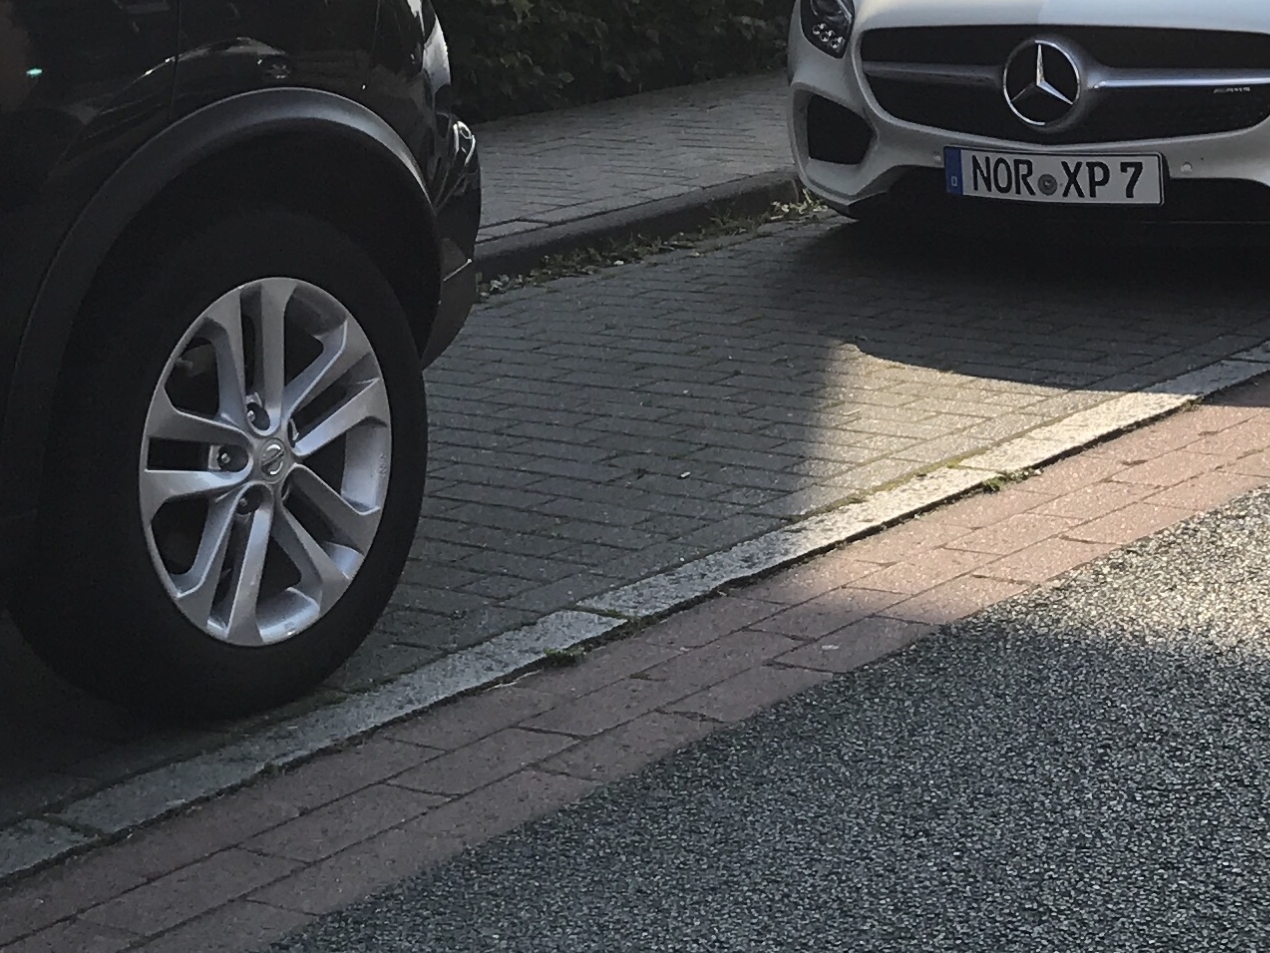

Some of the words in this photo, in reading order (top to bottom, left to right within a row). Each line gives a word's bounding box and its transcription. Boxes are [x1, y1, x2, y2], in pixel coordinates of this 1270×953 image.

[972, 154, 1036, 196] NOR
[1061, 161, 1110, 198] XP
[1120, 161, 1143, 198] 7
